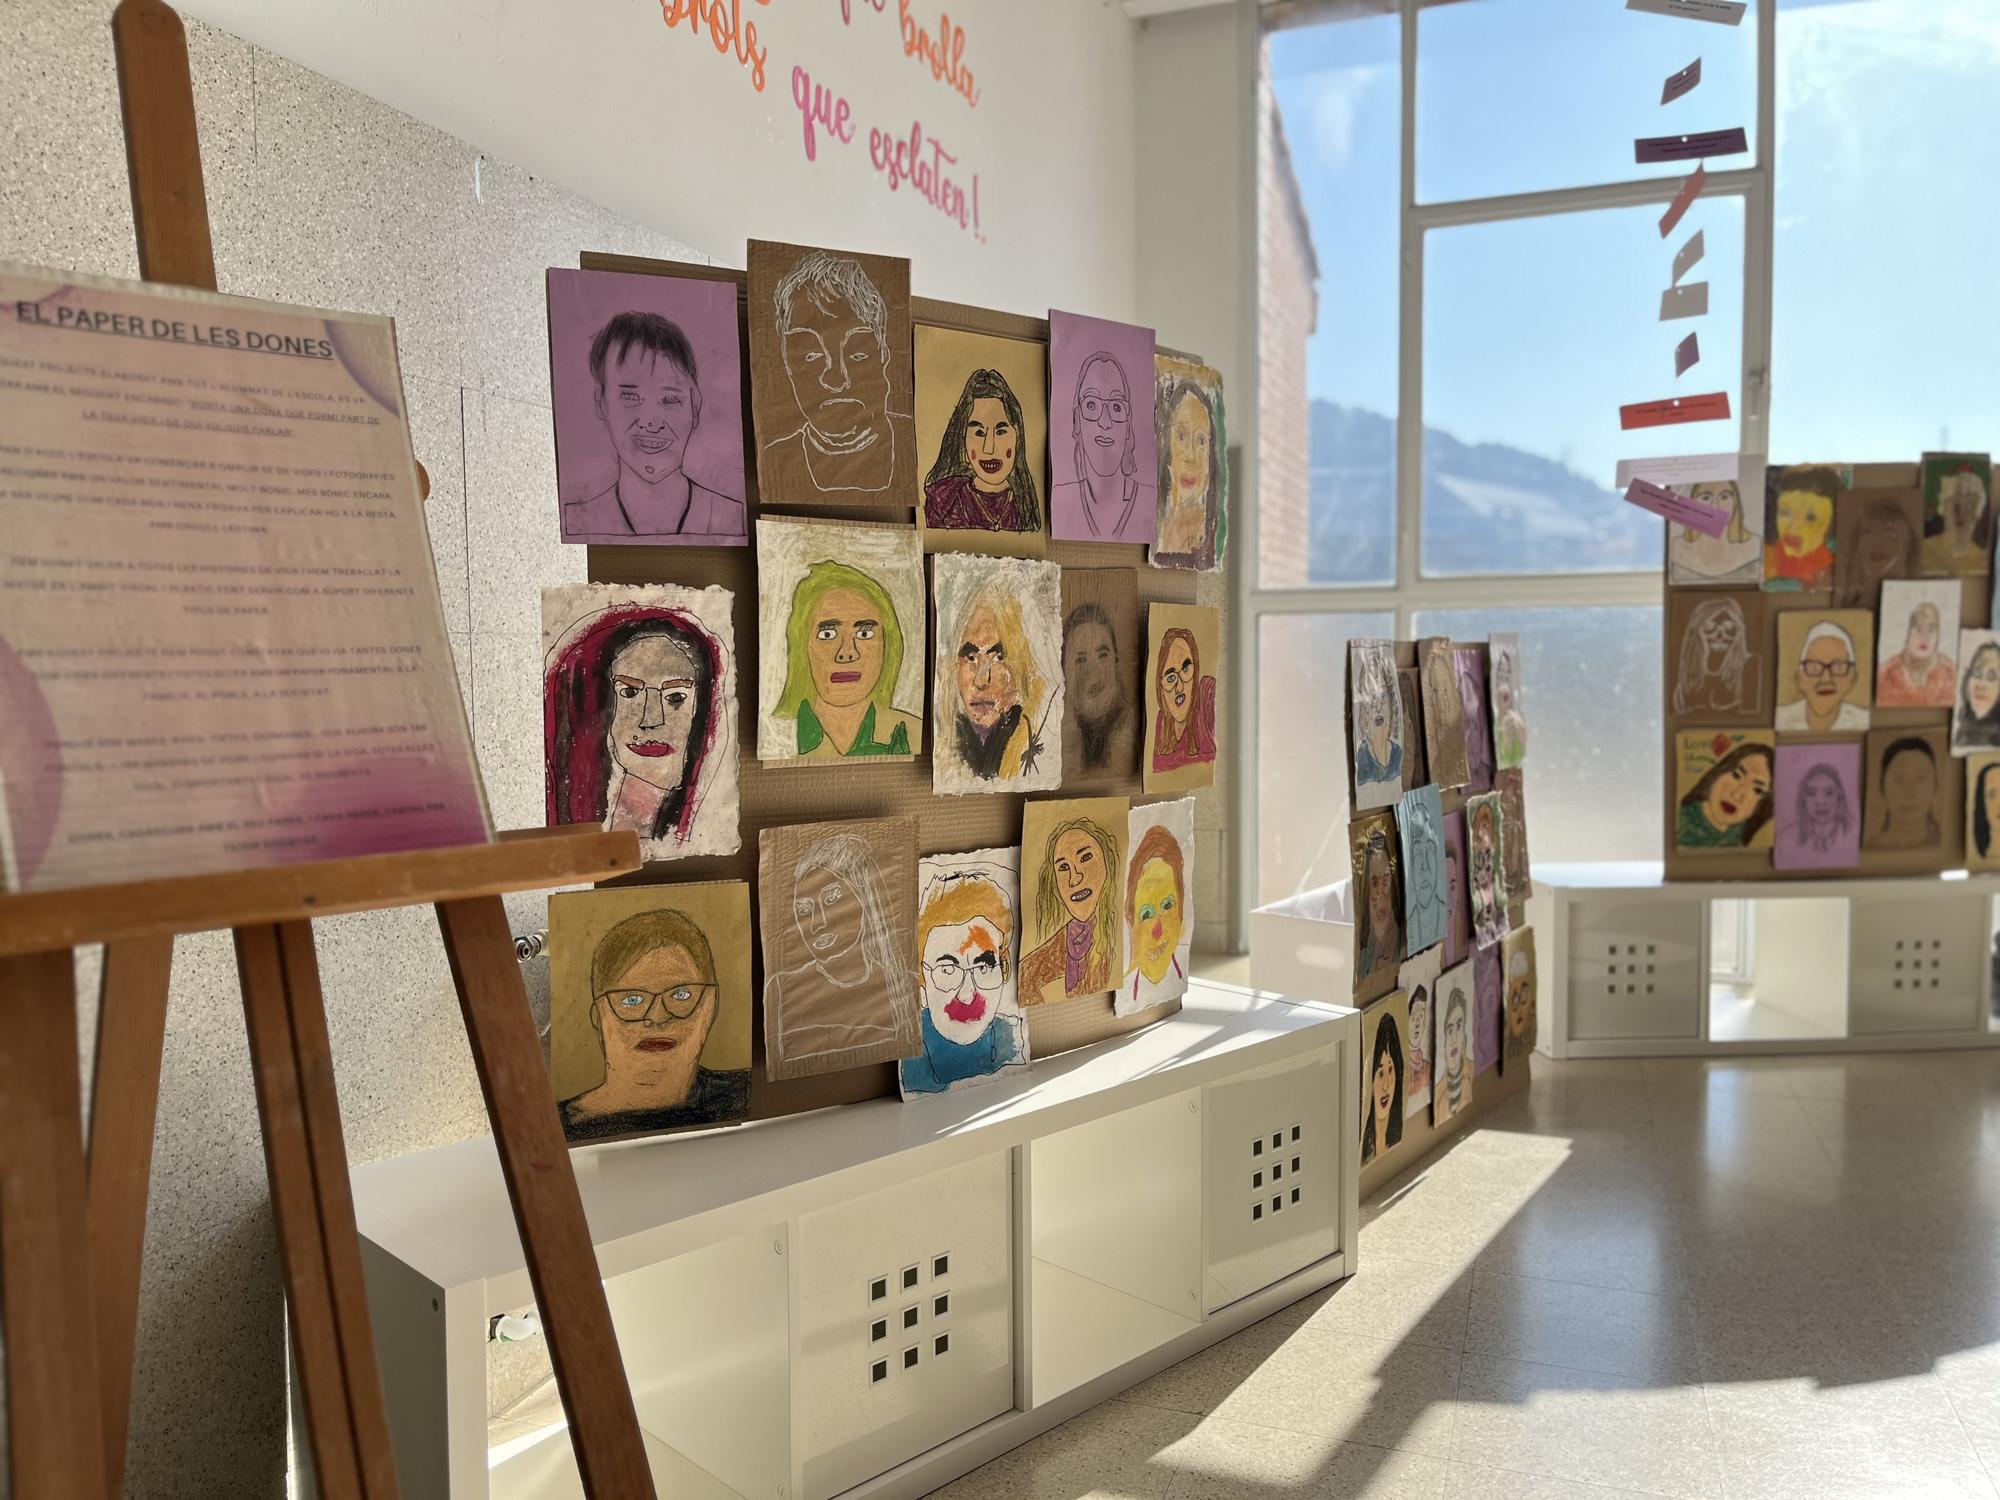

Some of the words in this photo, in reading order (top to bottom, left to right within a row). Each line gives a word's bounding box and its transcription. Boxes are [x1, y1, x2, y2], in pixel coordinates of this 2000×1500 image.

[792, 65, 855, 161] que
[869, 120, 987, 245] esclaten!
[16, 301, 52, 324] EL
[57, 306, 145, 338] PAPER
[152, 318, 188, 342] DE
[192, 324, 240, 349] LES
[247, 331, 334, 359] DONES
[329, 469, 396, 482] FOTOGRAFIES
